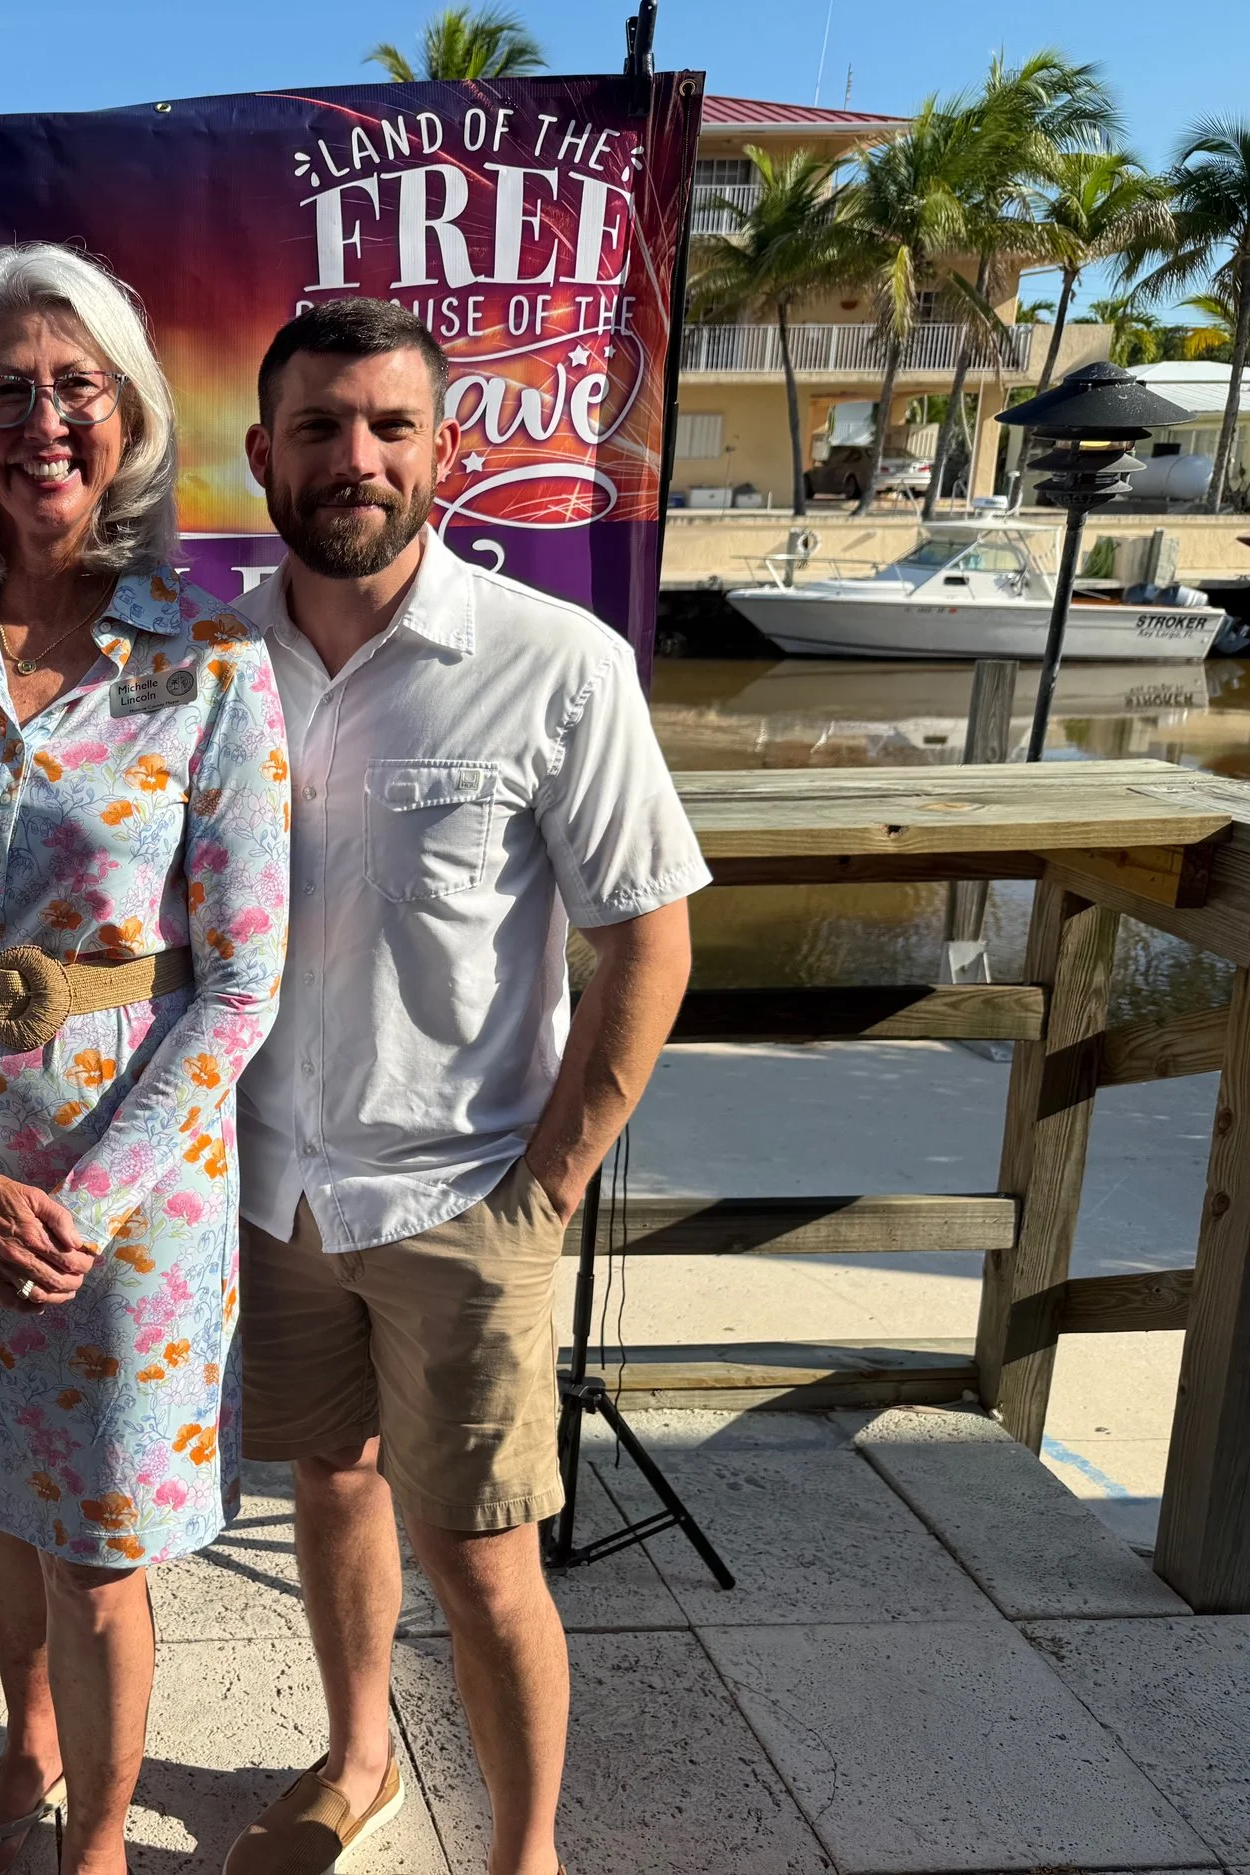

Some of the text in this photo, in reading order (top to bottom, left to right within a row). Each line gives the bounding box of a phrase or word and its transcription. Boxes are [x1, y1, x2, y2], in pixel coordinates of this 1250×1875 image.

[317, 108, 621, 177] LAND OF THE
[299, 161, 636, 293] FREE
[507, 294, 553, 337] OF
[574, 294, 637, 337] THE
[444, 362, 612, 445] ave
[1136, 615, 1208, 630] STROKER
[118, 679, 159, 696] Michelle
[121, 692, 156, 706] Lincoln
